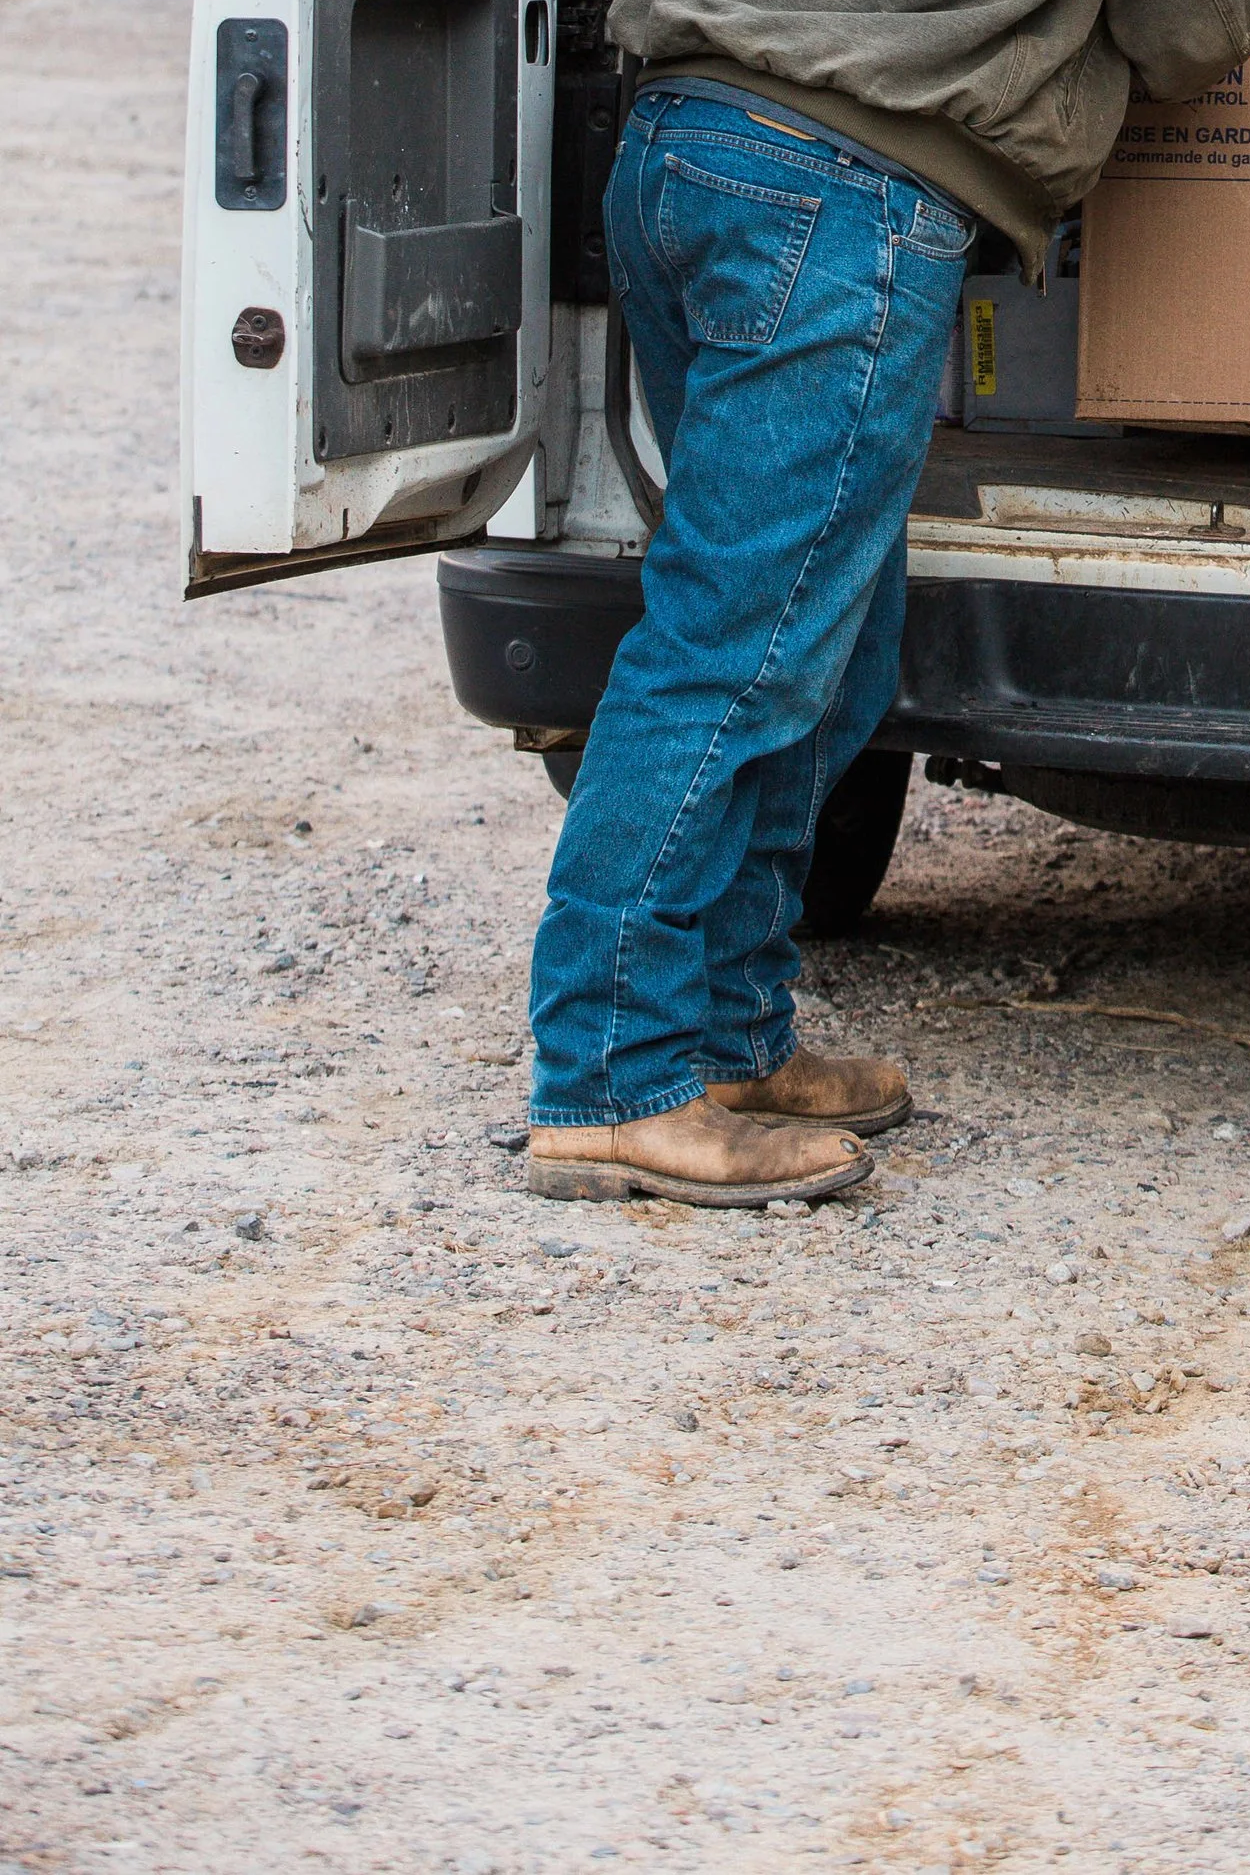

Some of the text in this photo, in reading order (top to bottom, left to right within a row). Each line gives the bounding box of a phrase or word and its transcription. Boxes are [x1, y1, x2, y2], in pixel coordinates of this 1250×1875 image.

[1129, 91, 1162, 104] GA
[1162, 126, 1189, 143] EN
[1115, 150, 1203, 164] Commande
[1207, 150, 1227, 165] du
